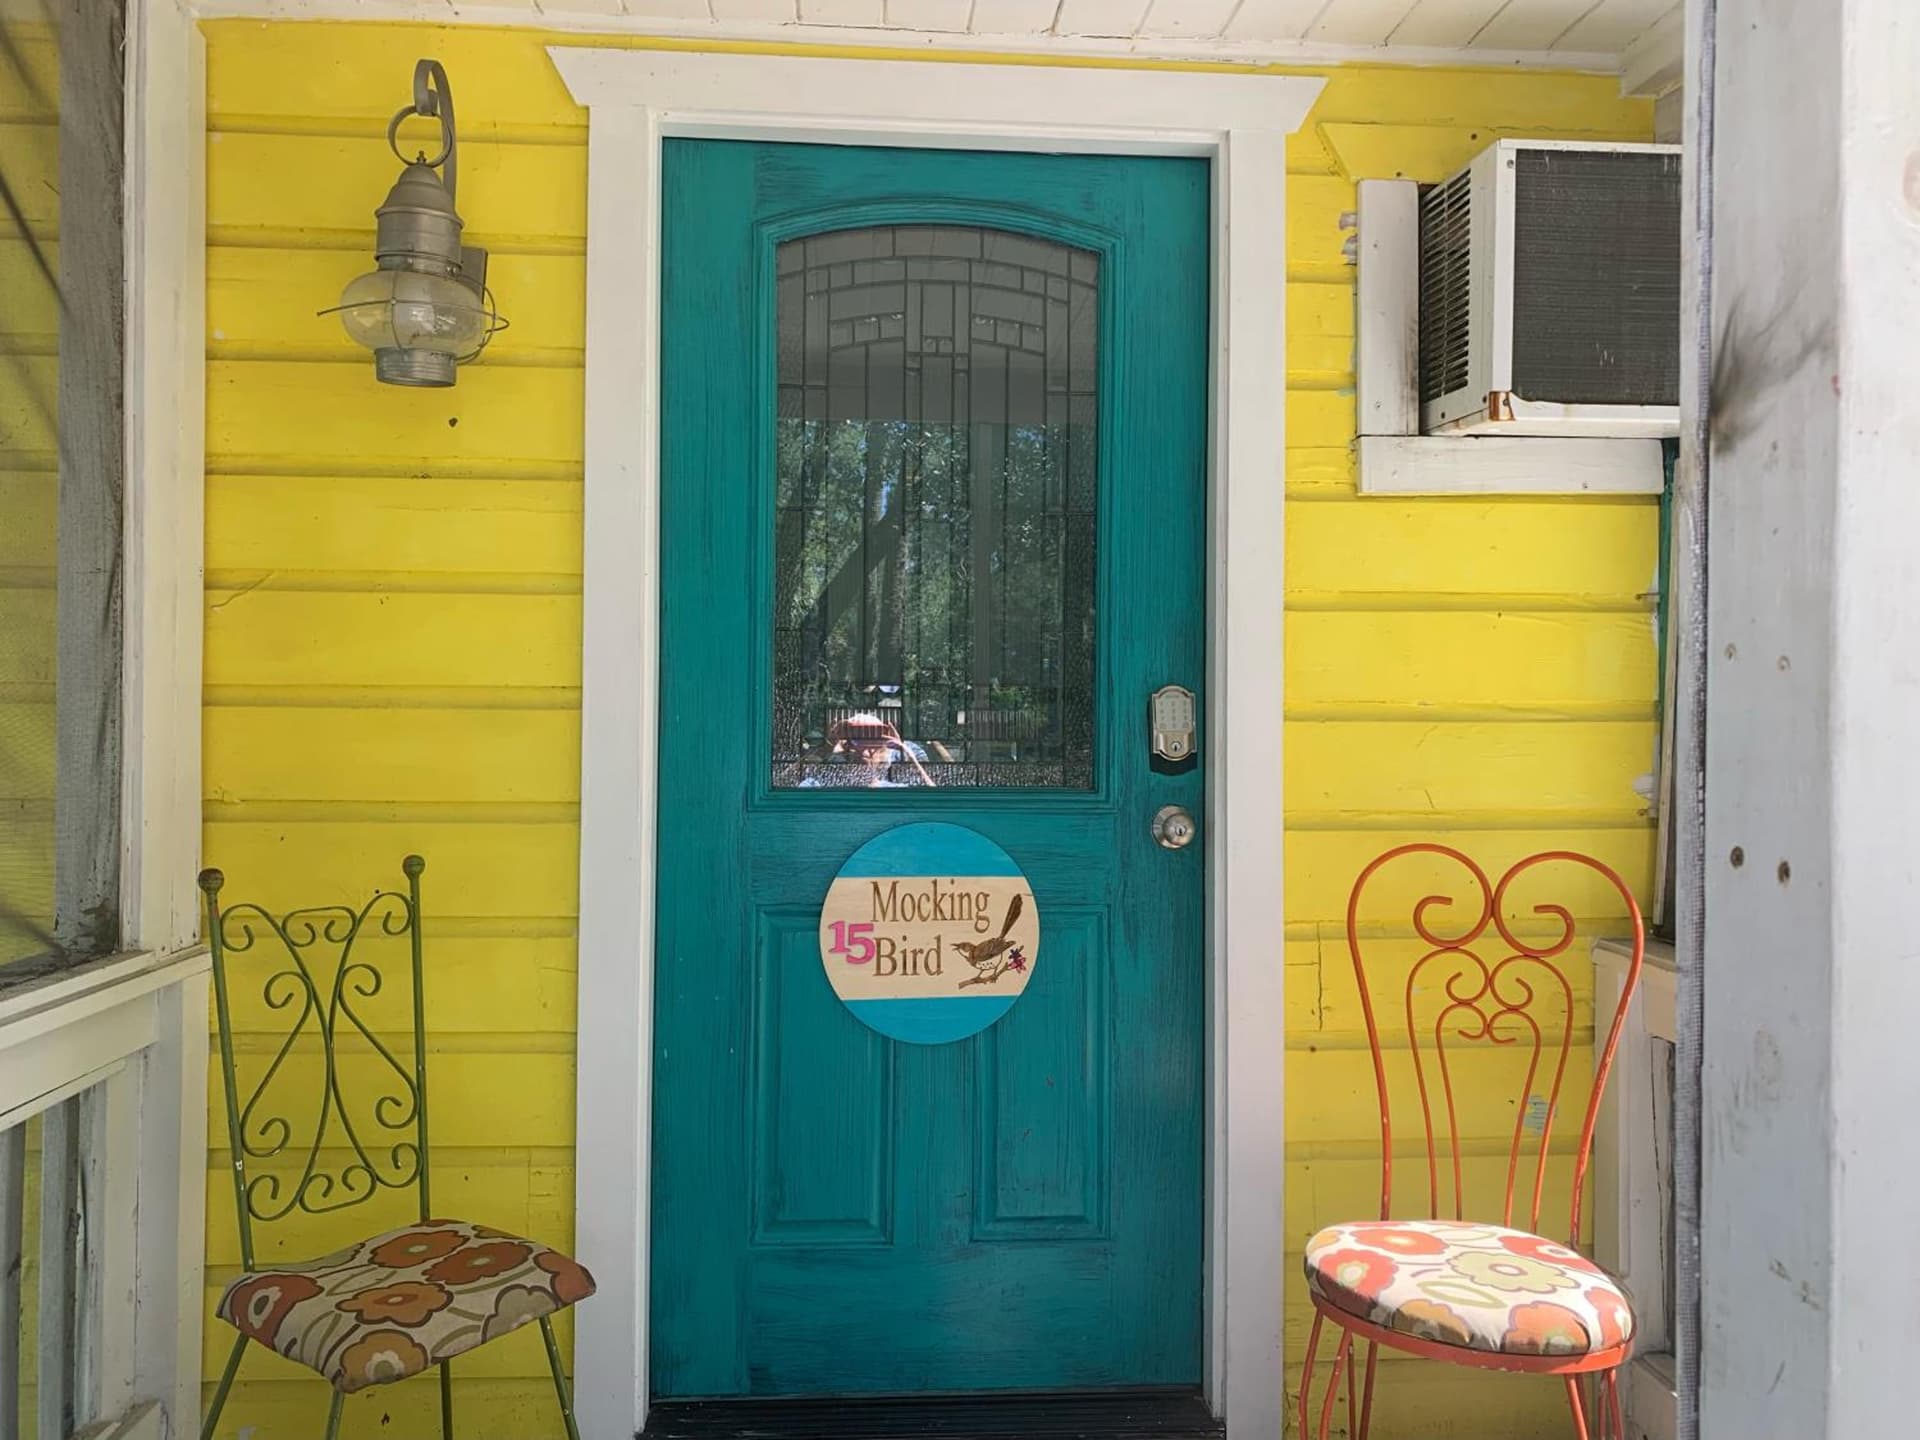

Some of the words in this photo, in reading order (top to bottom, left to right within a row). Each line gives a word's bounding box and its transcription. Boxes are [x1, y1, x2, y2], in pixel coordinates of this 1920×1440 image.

[870, 878, 991, 934] Mocking
[828, 920, 876, 965] 15
[872, 935, 944, 977] Bird
